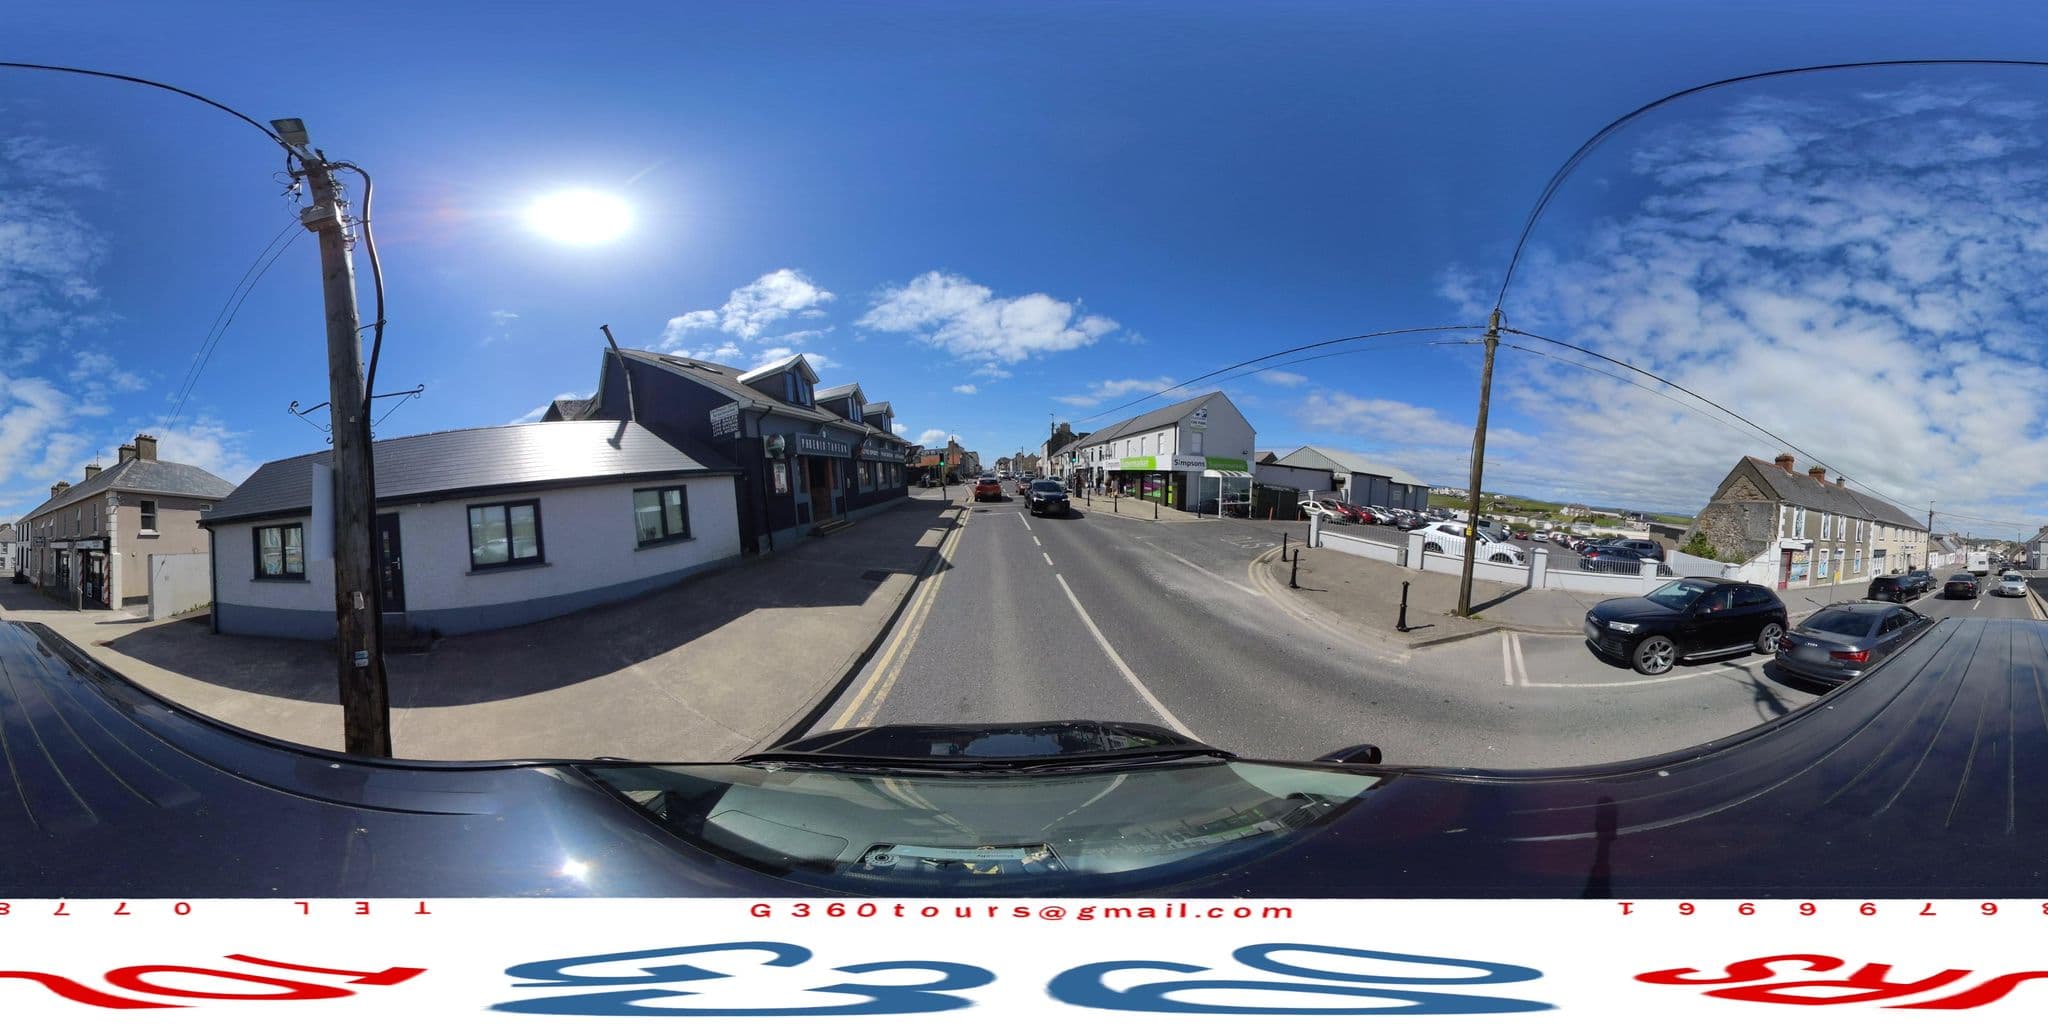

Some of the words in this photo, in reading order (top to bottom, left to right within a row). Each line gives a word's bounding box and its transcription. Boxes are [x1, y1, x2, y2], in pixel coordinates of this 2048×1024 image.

[801, 438, 825, 450] PHOENIX
[828, 441, 848, 453] TAVERN
[1174, 458, 1205, 468] Simpsons
